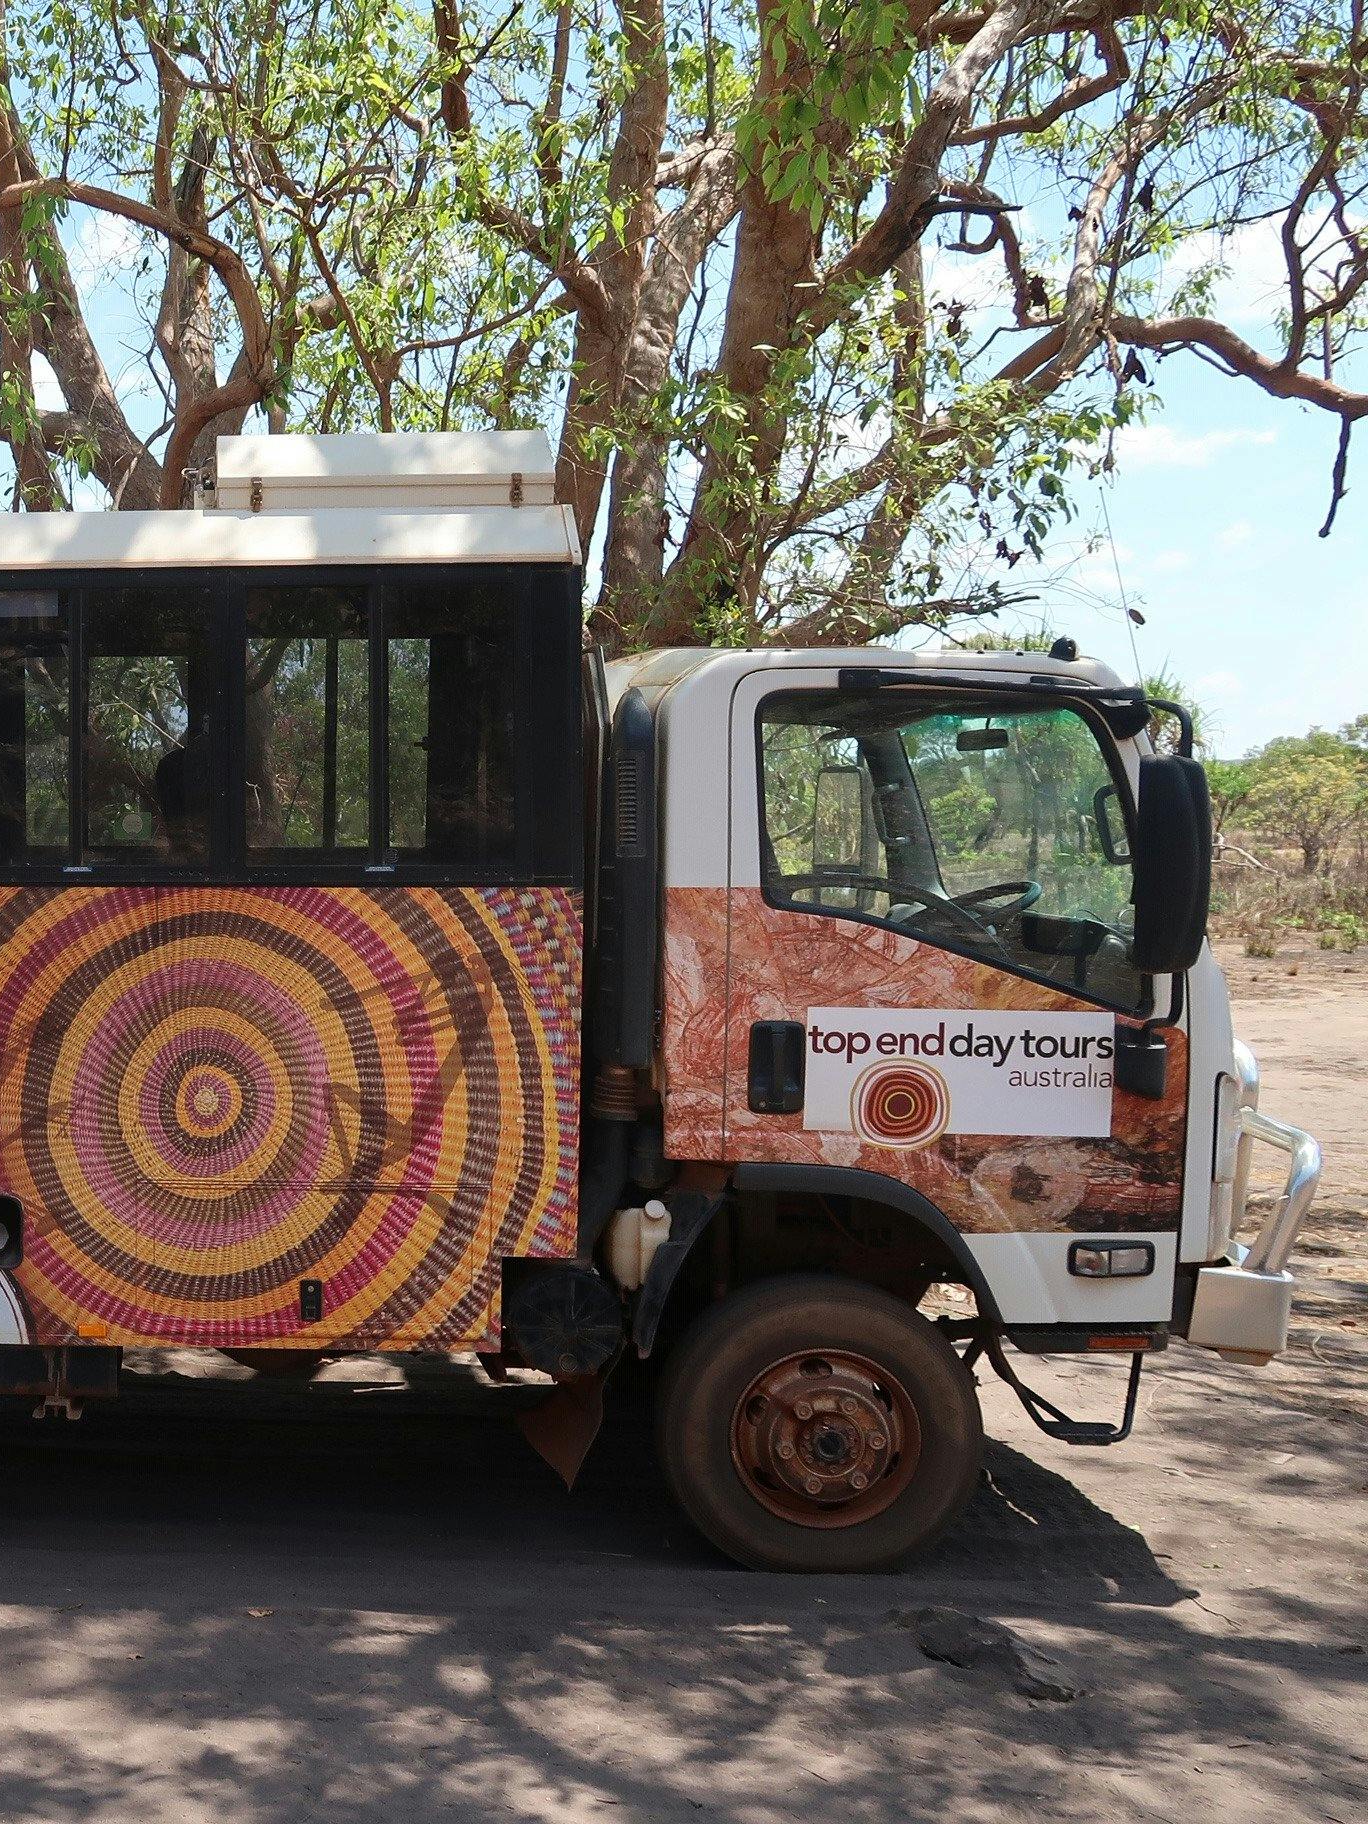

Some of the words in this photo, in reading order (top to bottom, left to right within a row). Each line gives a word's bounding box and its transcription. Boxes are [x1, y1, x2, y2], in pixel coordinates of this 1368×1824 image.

[808, 1025, 871, 1064] top
[876, 1022, 946, 1056] end
[949, 1023, 1015, 1067] day
[1020, 1030, 1114, 1059] tours
[1008, 1063, 1113, 1088] australia
